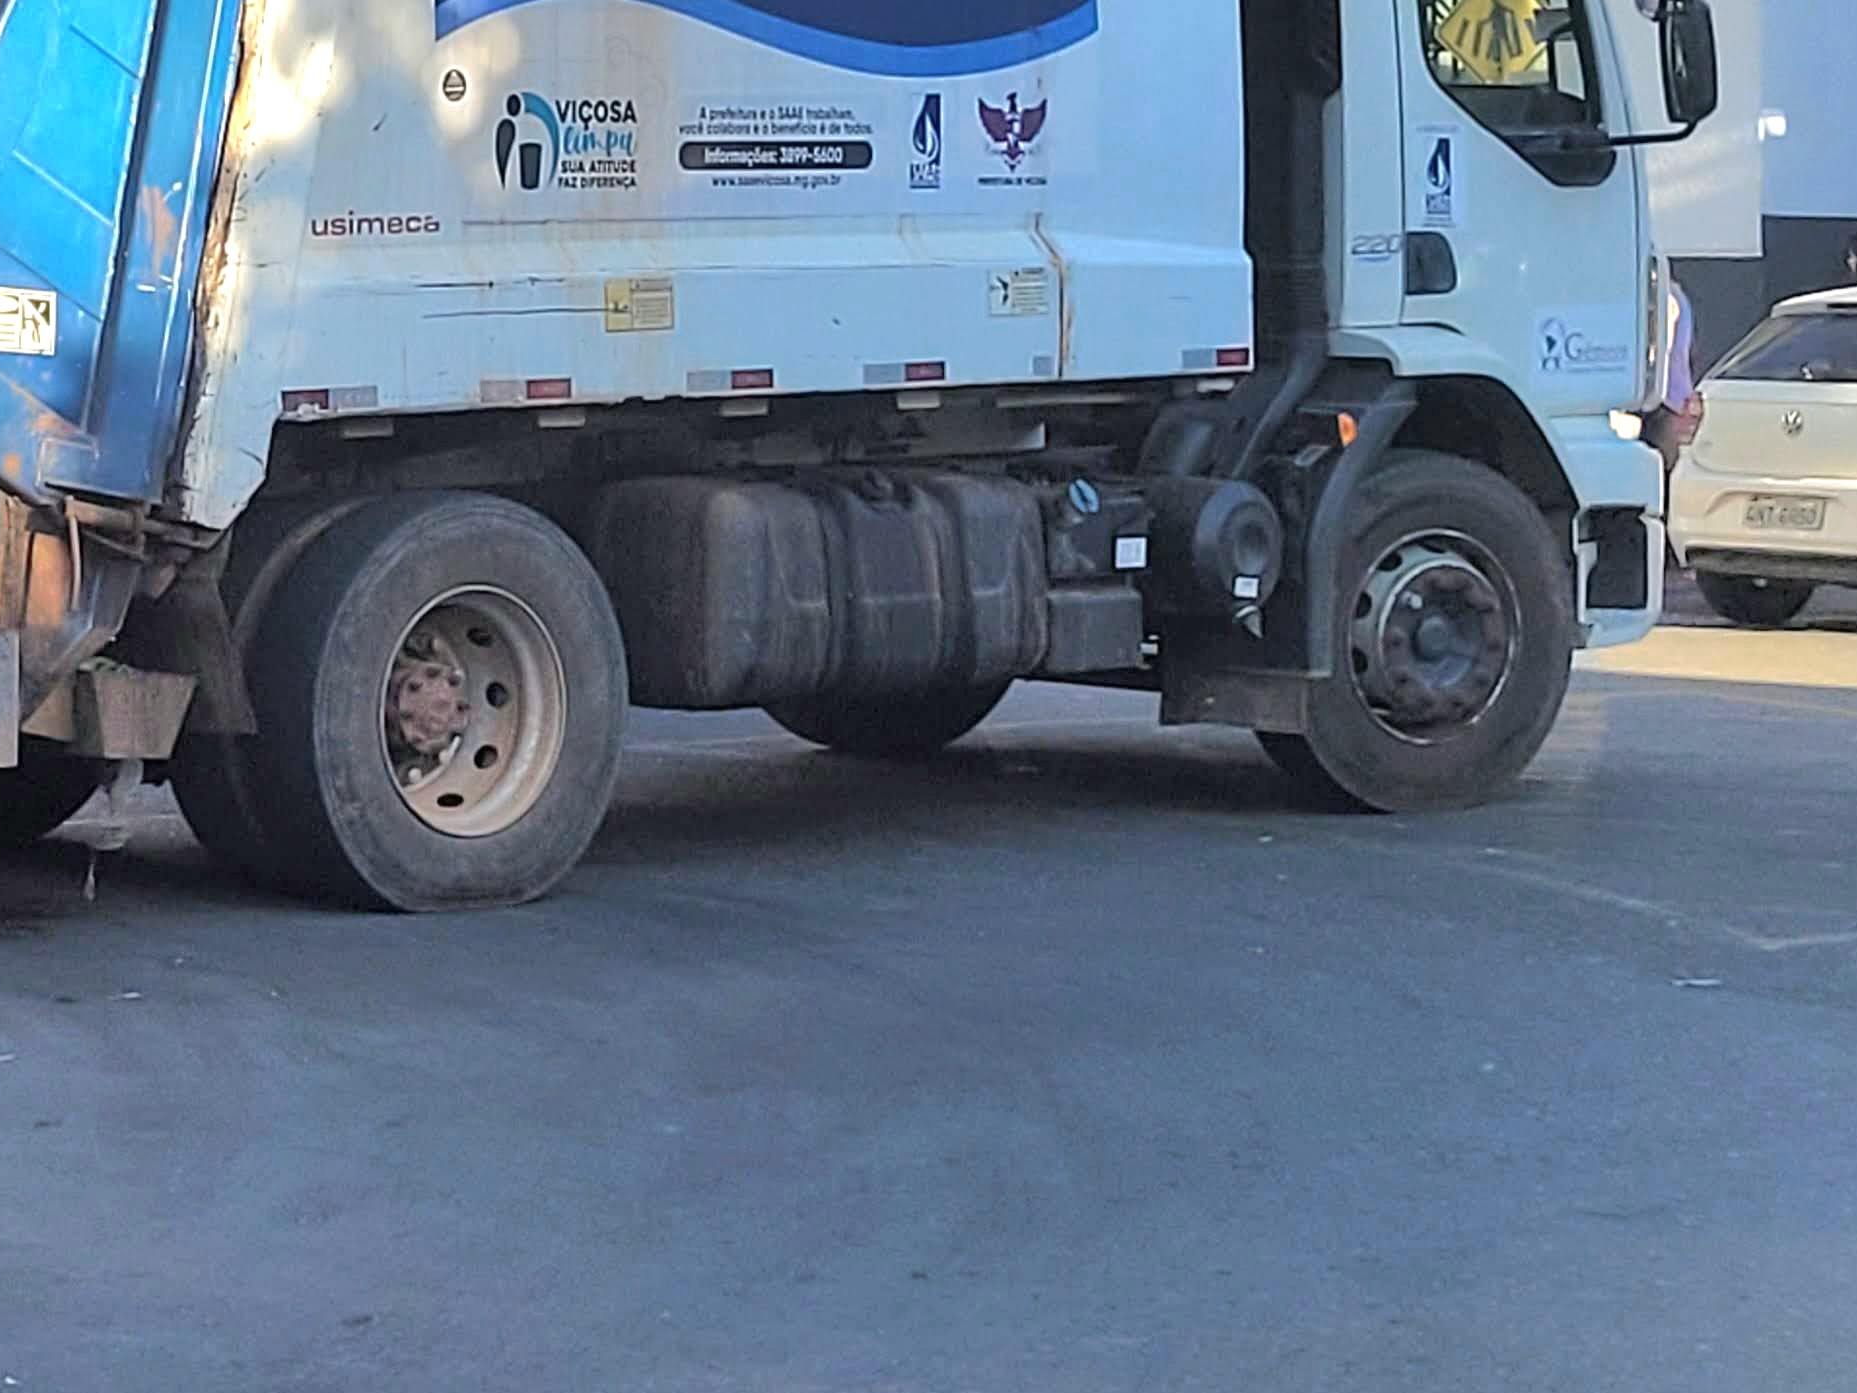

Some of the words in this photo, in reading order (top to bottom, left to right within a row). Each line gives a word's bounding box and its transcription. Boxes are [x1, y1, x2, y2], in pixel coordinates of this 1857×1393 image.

[554, 99, 638, 131] VIÇOSA
[560, 160, 586, 174] SUA
[589, 159, 637, 174] ATITUDE
[557, 176, 578, 189] FAZ
[580, 176, 638, 191] DIFERENÇA
[310, 209, 441, 237] usimeca
